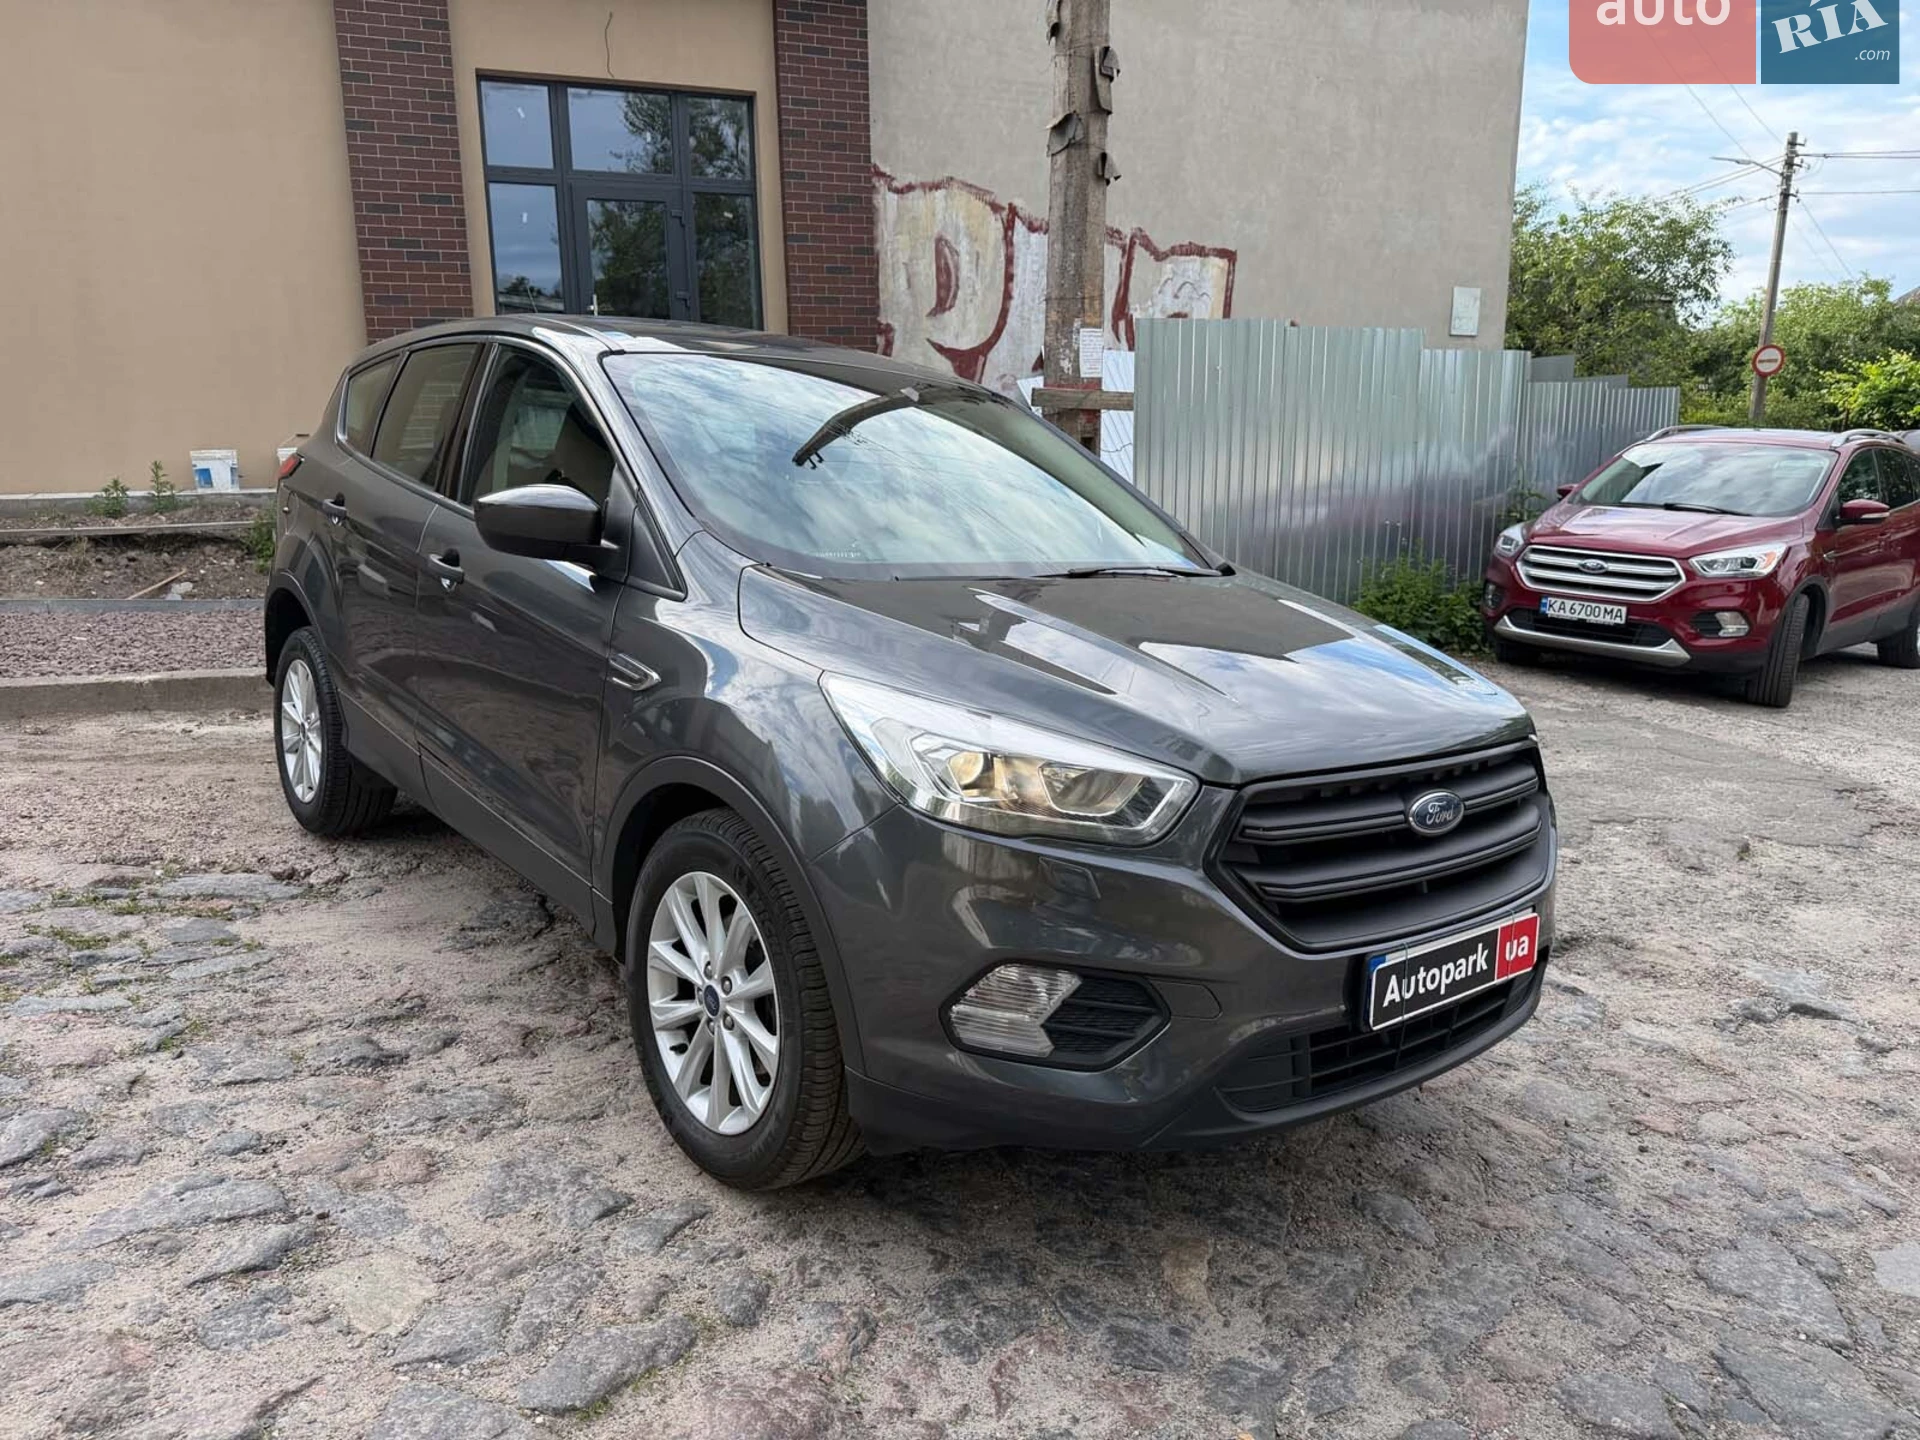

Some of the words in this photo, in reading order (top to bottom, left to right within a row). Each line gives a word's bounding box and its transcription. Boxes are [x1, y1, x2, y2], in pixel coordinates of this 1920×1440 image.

[1547, 600, 1566, 613] KA
[1569, 602, 1601, 618] 6700
[1603, 606, 1623, 621] MA
[1426, 801, 1454, 825] Ford
[1382, 943, 1489, 1008] Autopark
[1505, 935, 1529, 961] ua
